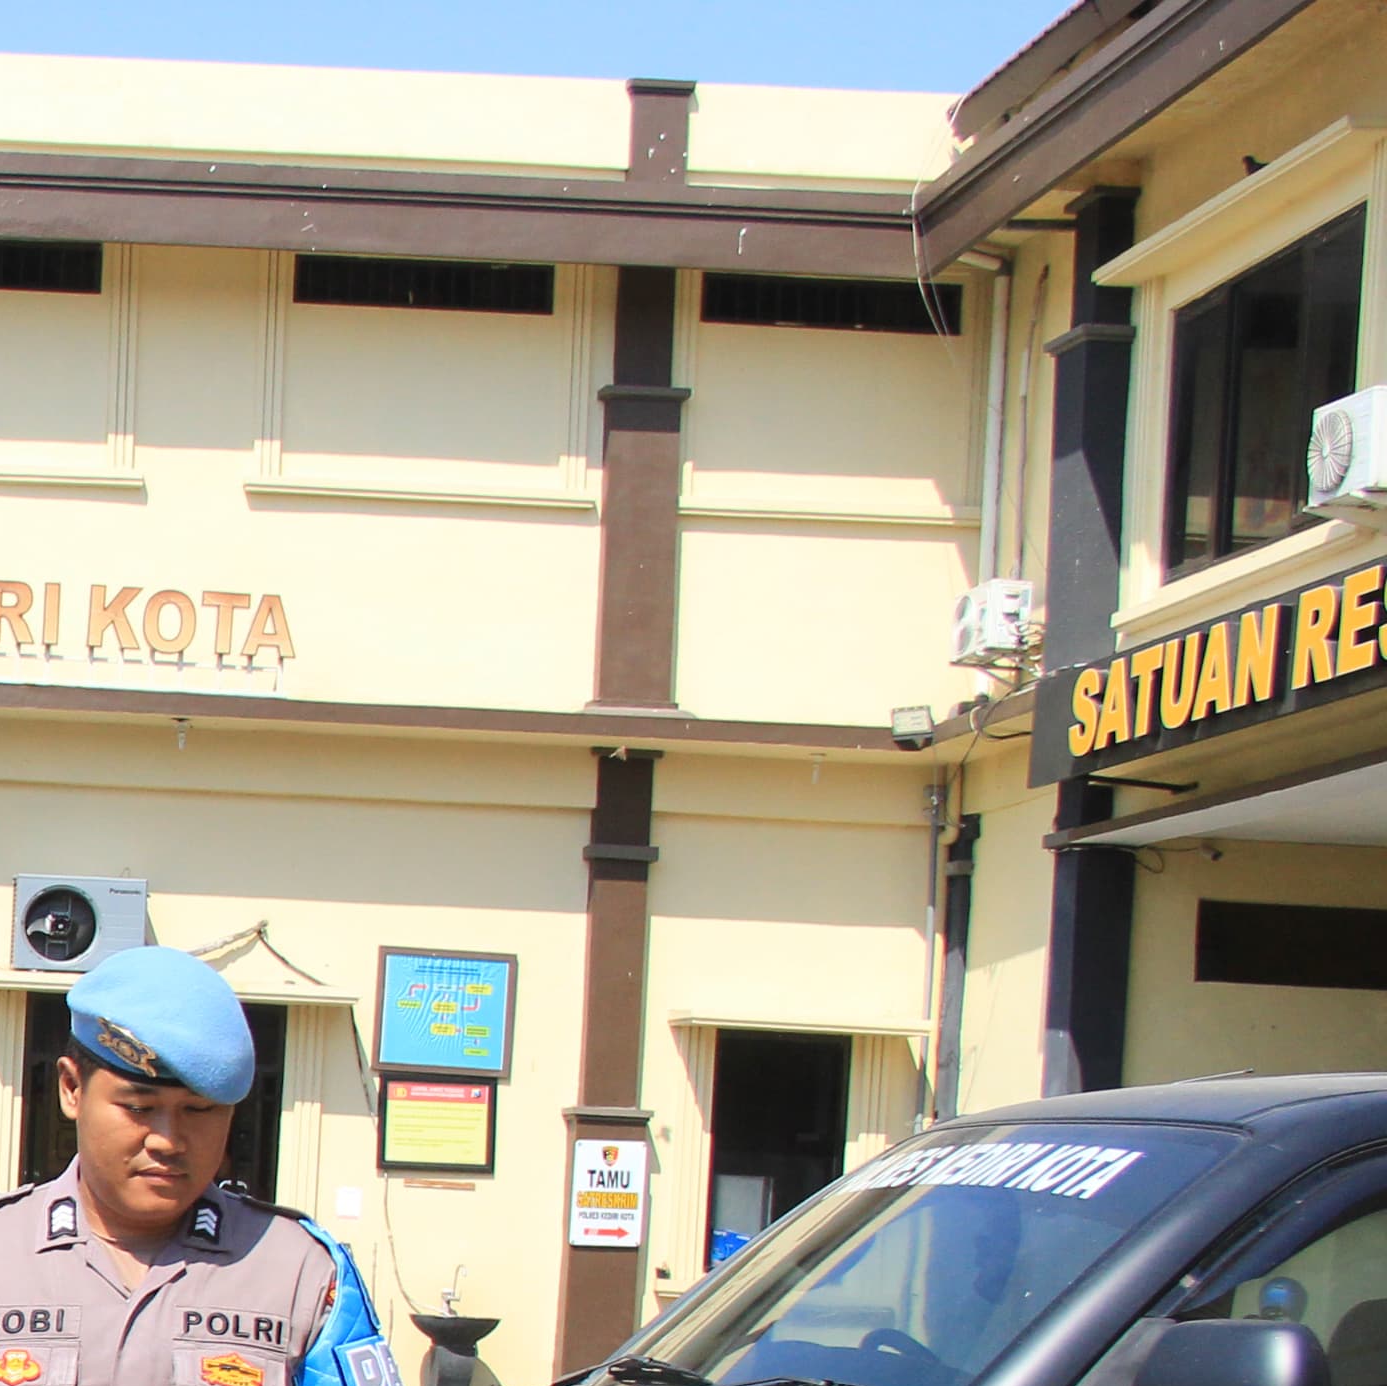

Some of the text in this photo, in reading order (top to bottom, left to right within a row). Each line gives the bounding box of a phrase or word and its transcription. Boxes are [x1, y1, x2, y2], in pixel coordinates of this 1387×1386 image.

[87, 583, 296, 658] KOTA
[1068, 564, 1387, 757] SATUAN RE
[587, 1169, 630, 1189] TAMU
[906, 1143, 1055, 1188] KEDIRI
[1003, 1144, 1144, 1200] KOTA
[183, 1310, 284, 1346] POLRI
